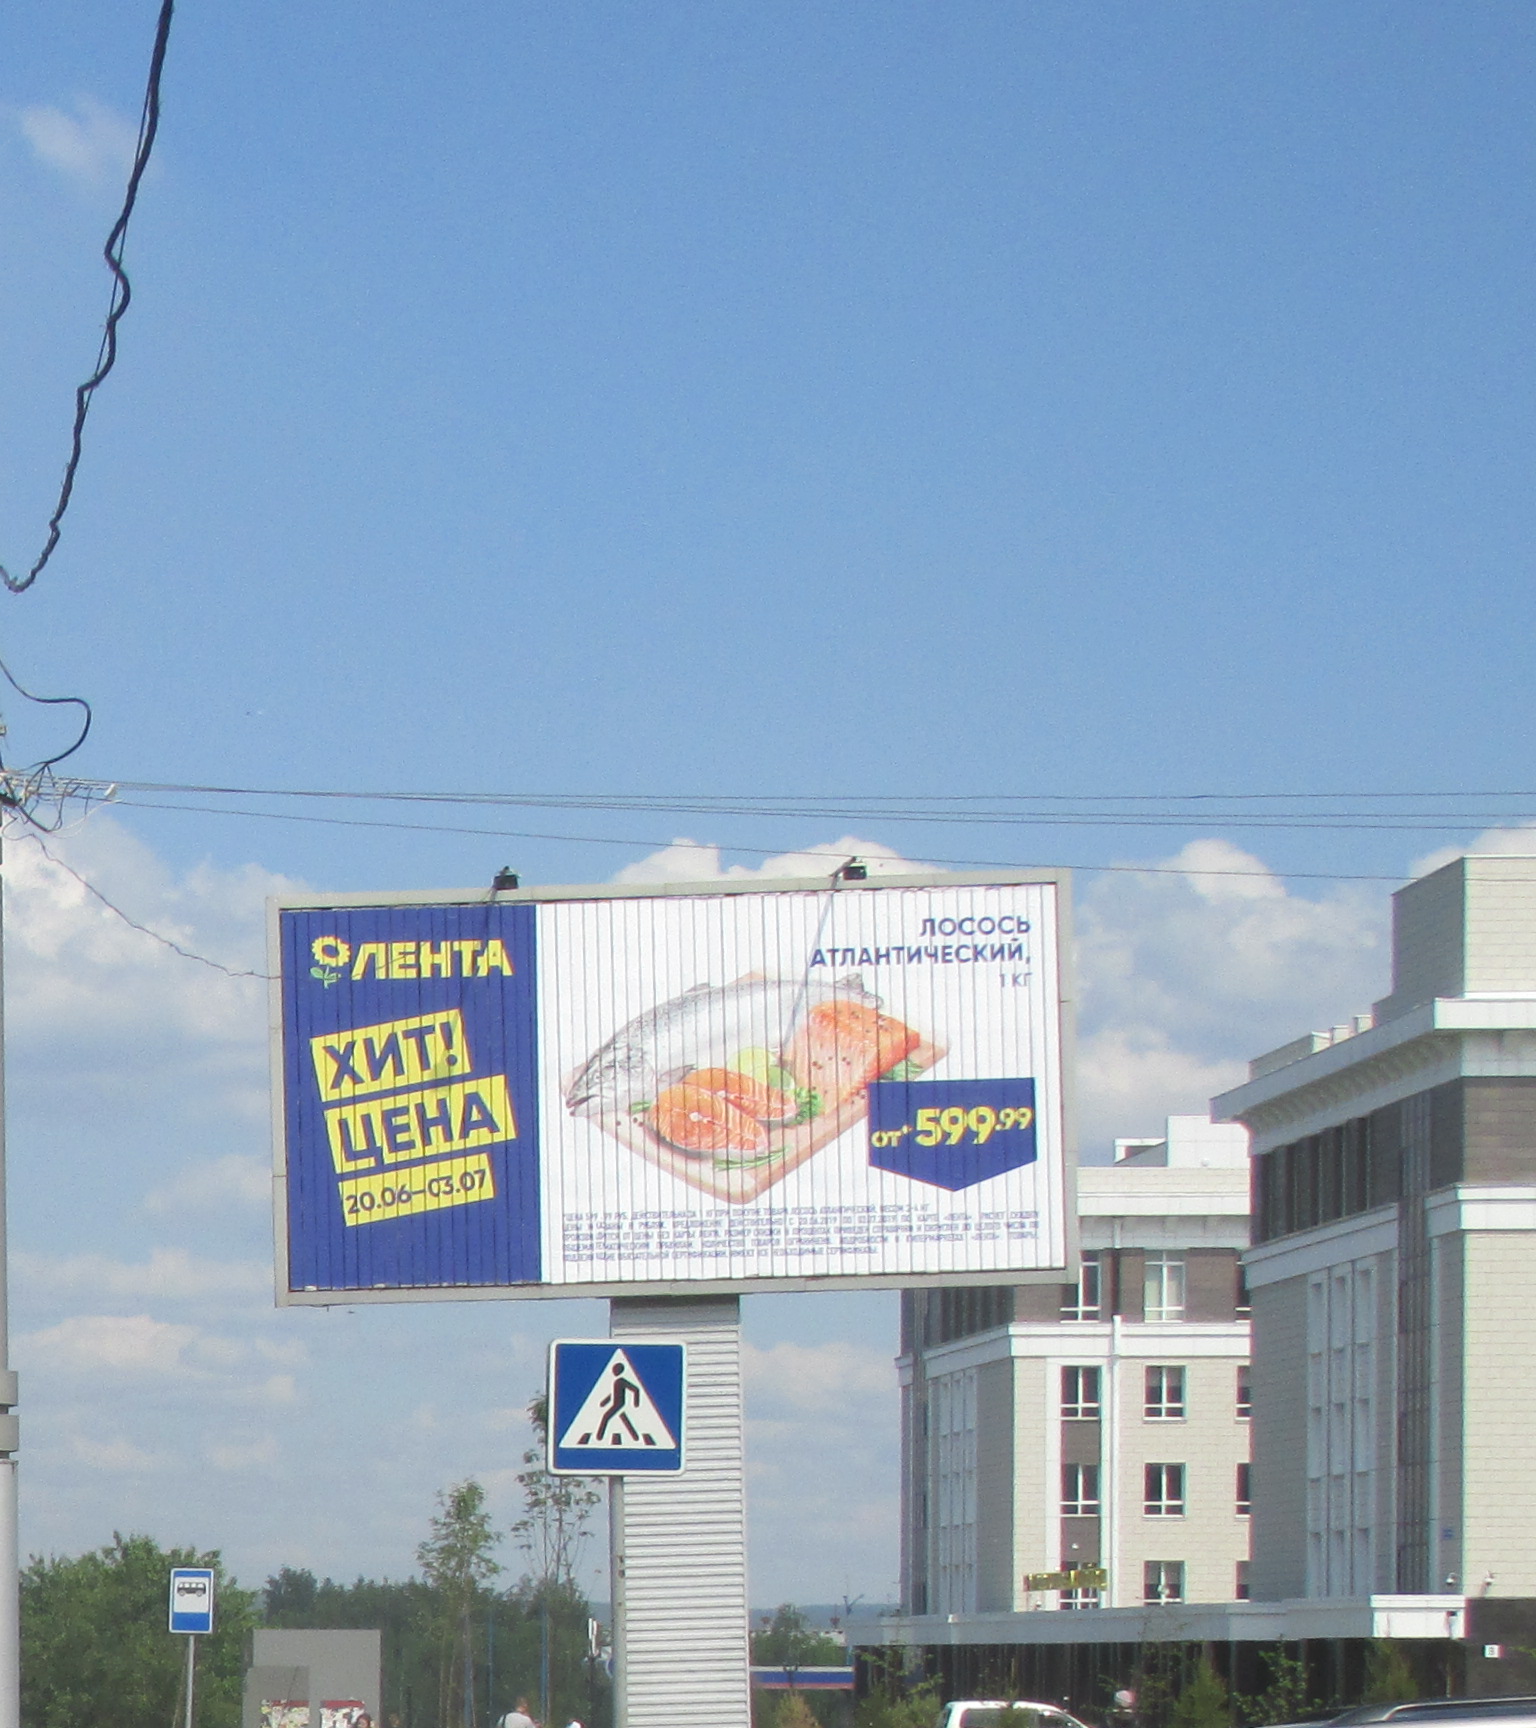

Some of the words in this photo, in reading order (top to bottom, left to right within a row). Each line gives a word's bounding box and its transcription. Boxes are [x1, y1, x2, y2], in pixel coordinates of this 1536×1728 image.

[919, 915, 1032, 938] ЛОСОСЬ
[351, 938, 514, 981] ЛЕНТА
[809, 937, 1032, 969] АТЛАНТИЧЕСКИЙ,
[322, 1019, 459, 1091] ХИТ!
[337, 1091, 501, 1167] ЦЕНА
